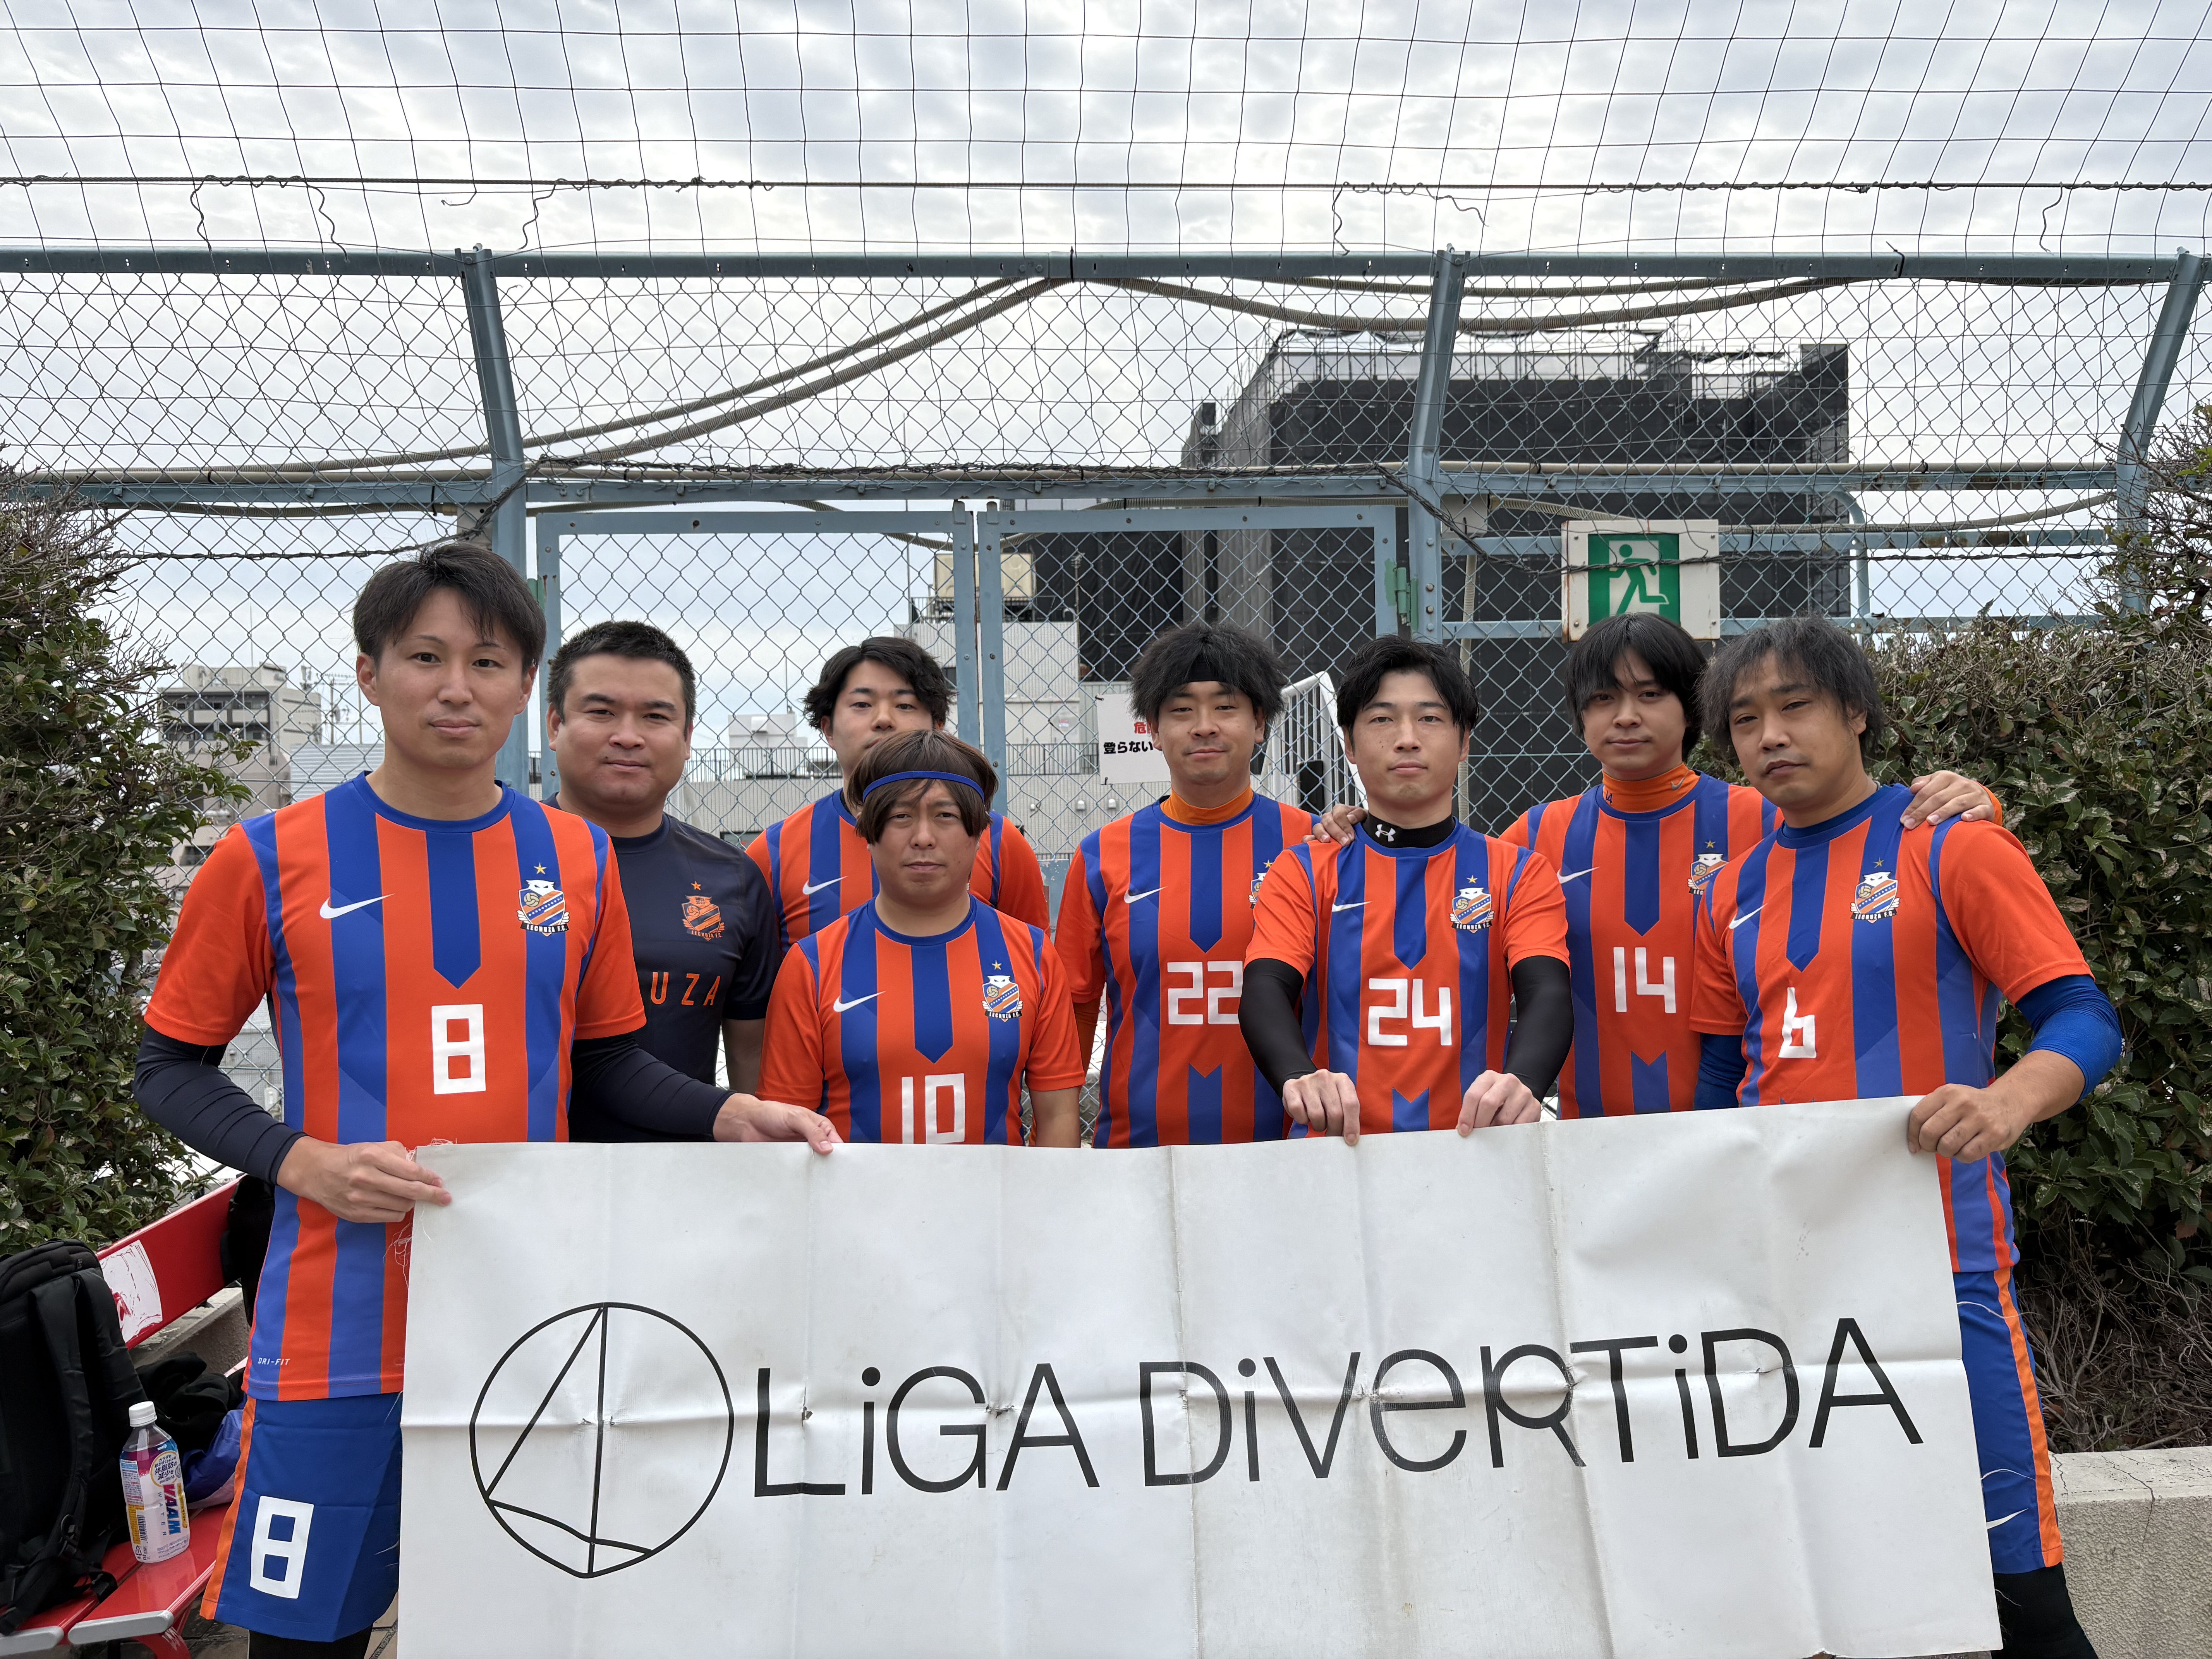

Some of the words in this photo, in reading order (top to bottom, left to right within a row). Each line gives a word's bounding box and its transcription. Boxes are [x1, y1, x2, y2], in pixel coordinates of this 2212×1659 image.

[1104, 741, 1163, 754] 登らない
[527, 924, 555, 933] LECHUZA
[1167, 960, 1243, 1025] 22
[1368, 978, 1452, 1046] 24
[1613, 946, 1676, 1013] 14
[431, 1003, 486, 1095] 8
[1778, 987, 1817, 1059] 6
[902, 1073, 965, 1144] 10
[258, 1357, 290, 1365] DRI-FIT
[158, 1492, 167, 1536] WATER
[163, 1484, 181, 1535] VAAM
[249, 1495, 314, 1599] 8
